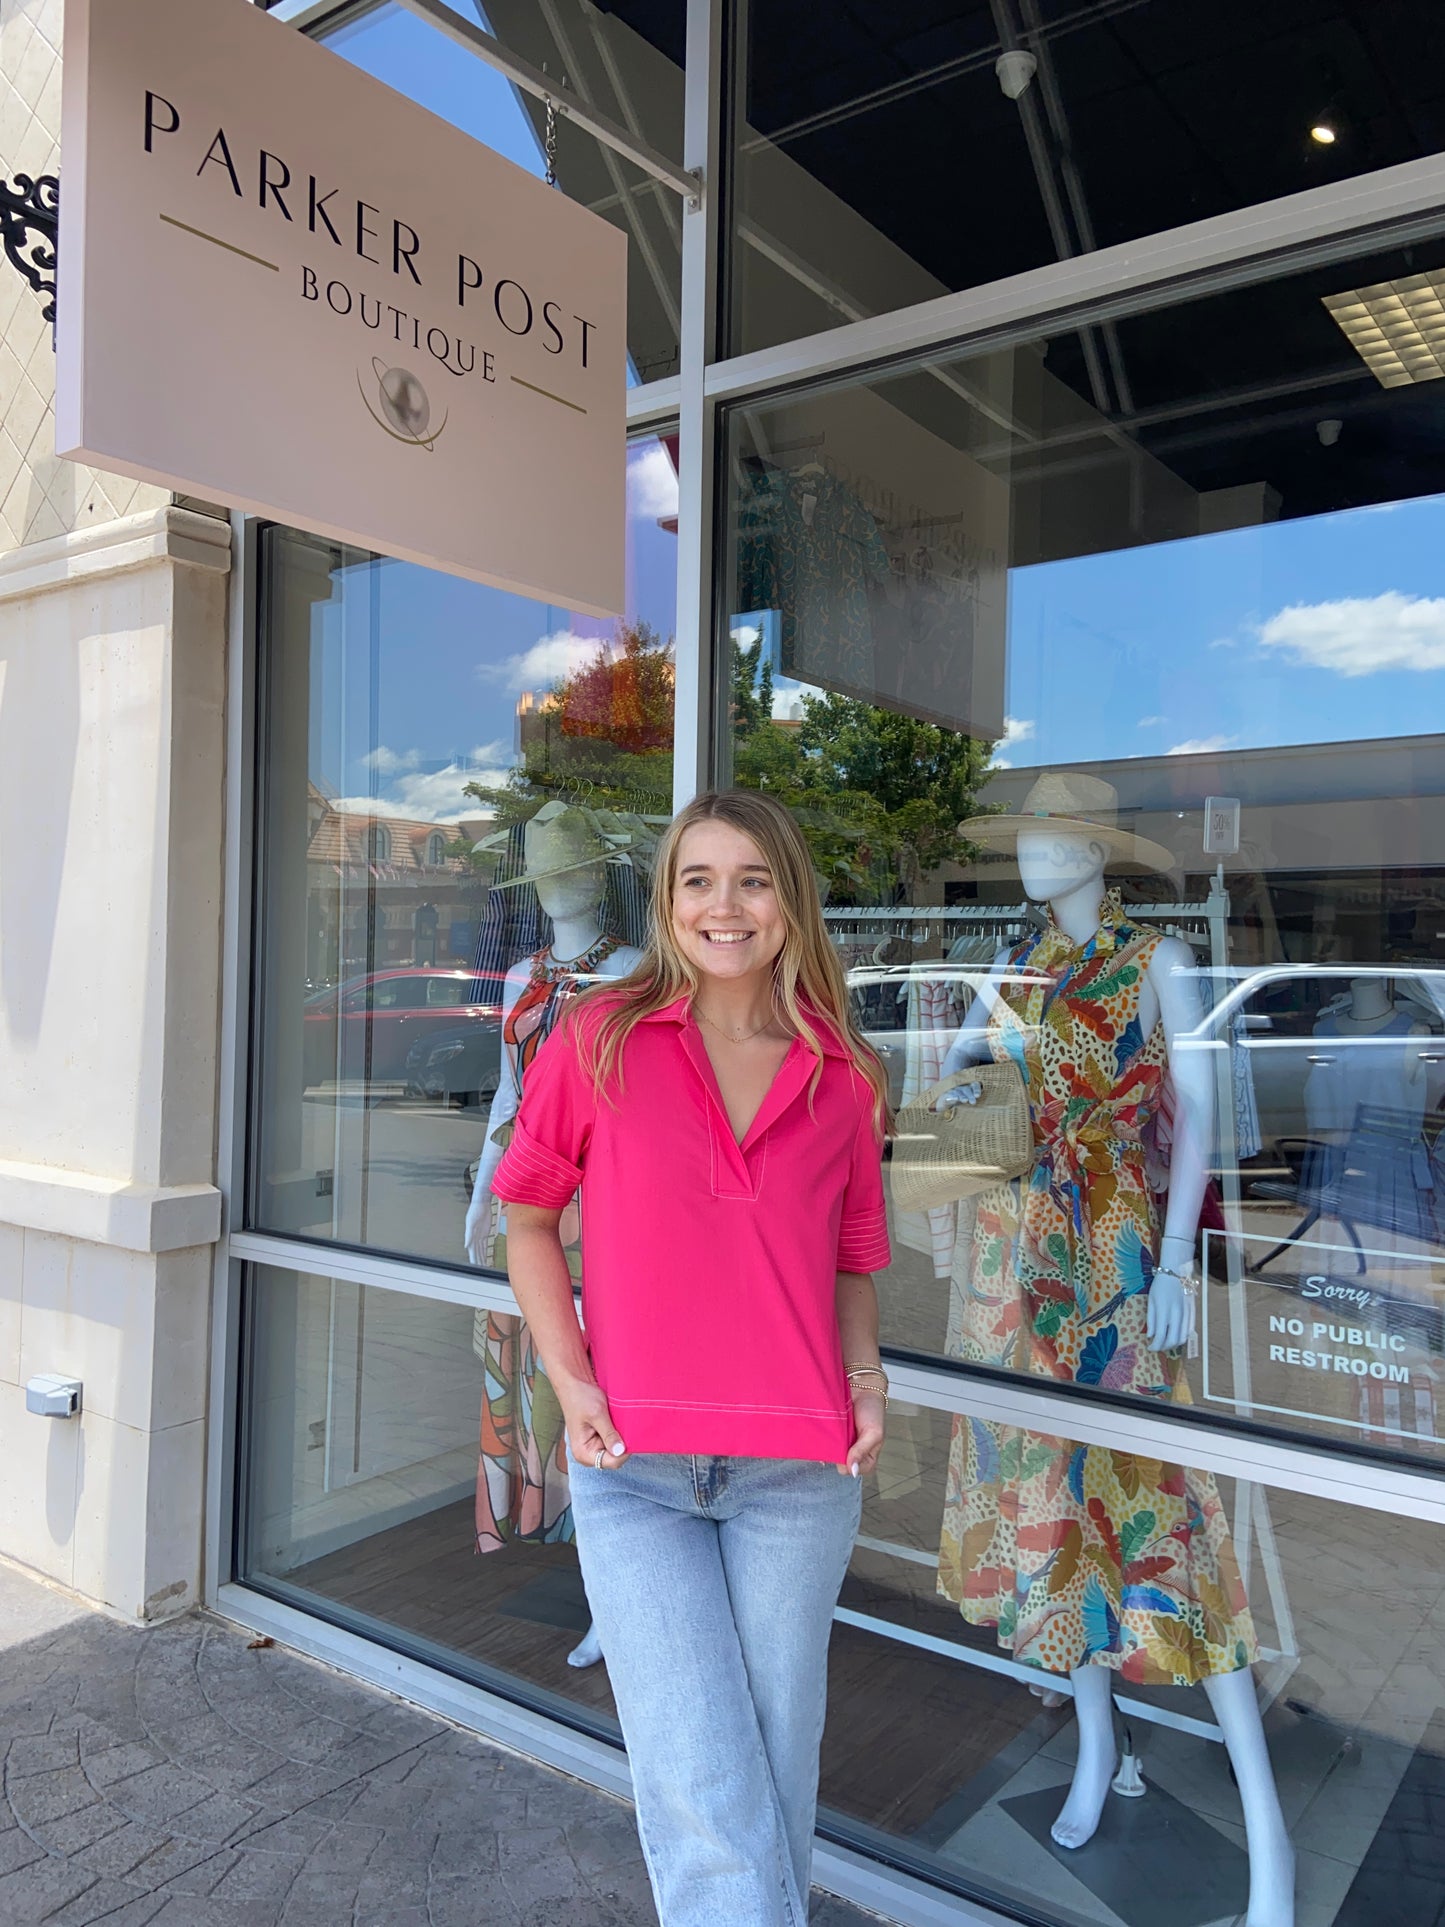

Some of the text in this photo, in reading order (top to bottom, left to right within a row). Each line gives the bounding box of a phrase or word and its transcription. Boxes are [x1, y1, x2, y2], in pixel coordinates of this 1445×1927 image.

[144, 90, 598, 370] PARKER POST
[300, 266, 497, 383] BOUTIQUE
[1269, 1315, 1406, 1352] NO PUBLIC
[1269, 1345, 1410, 1384] RESTROOM
